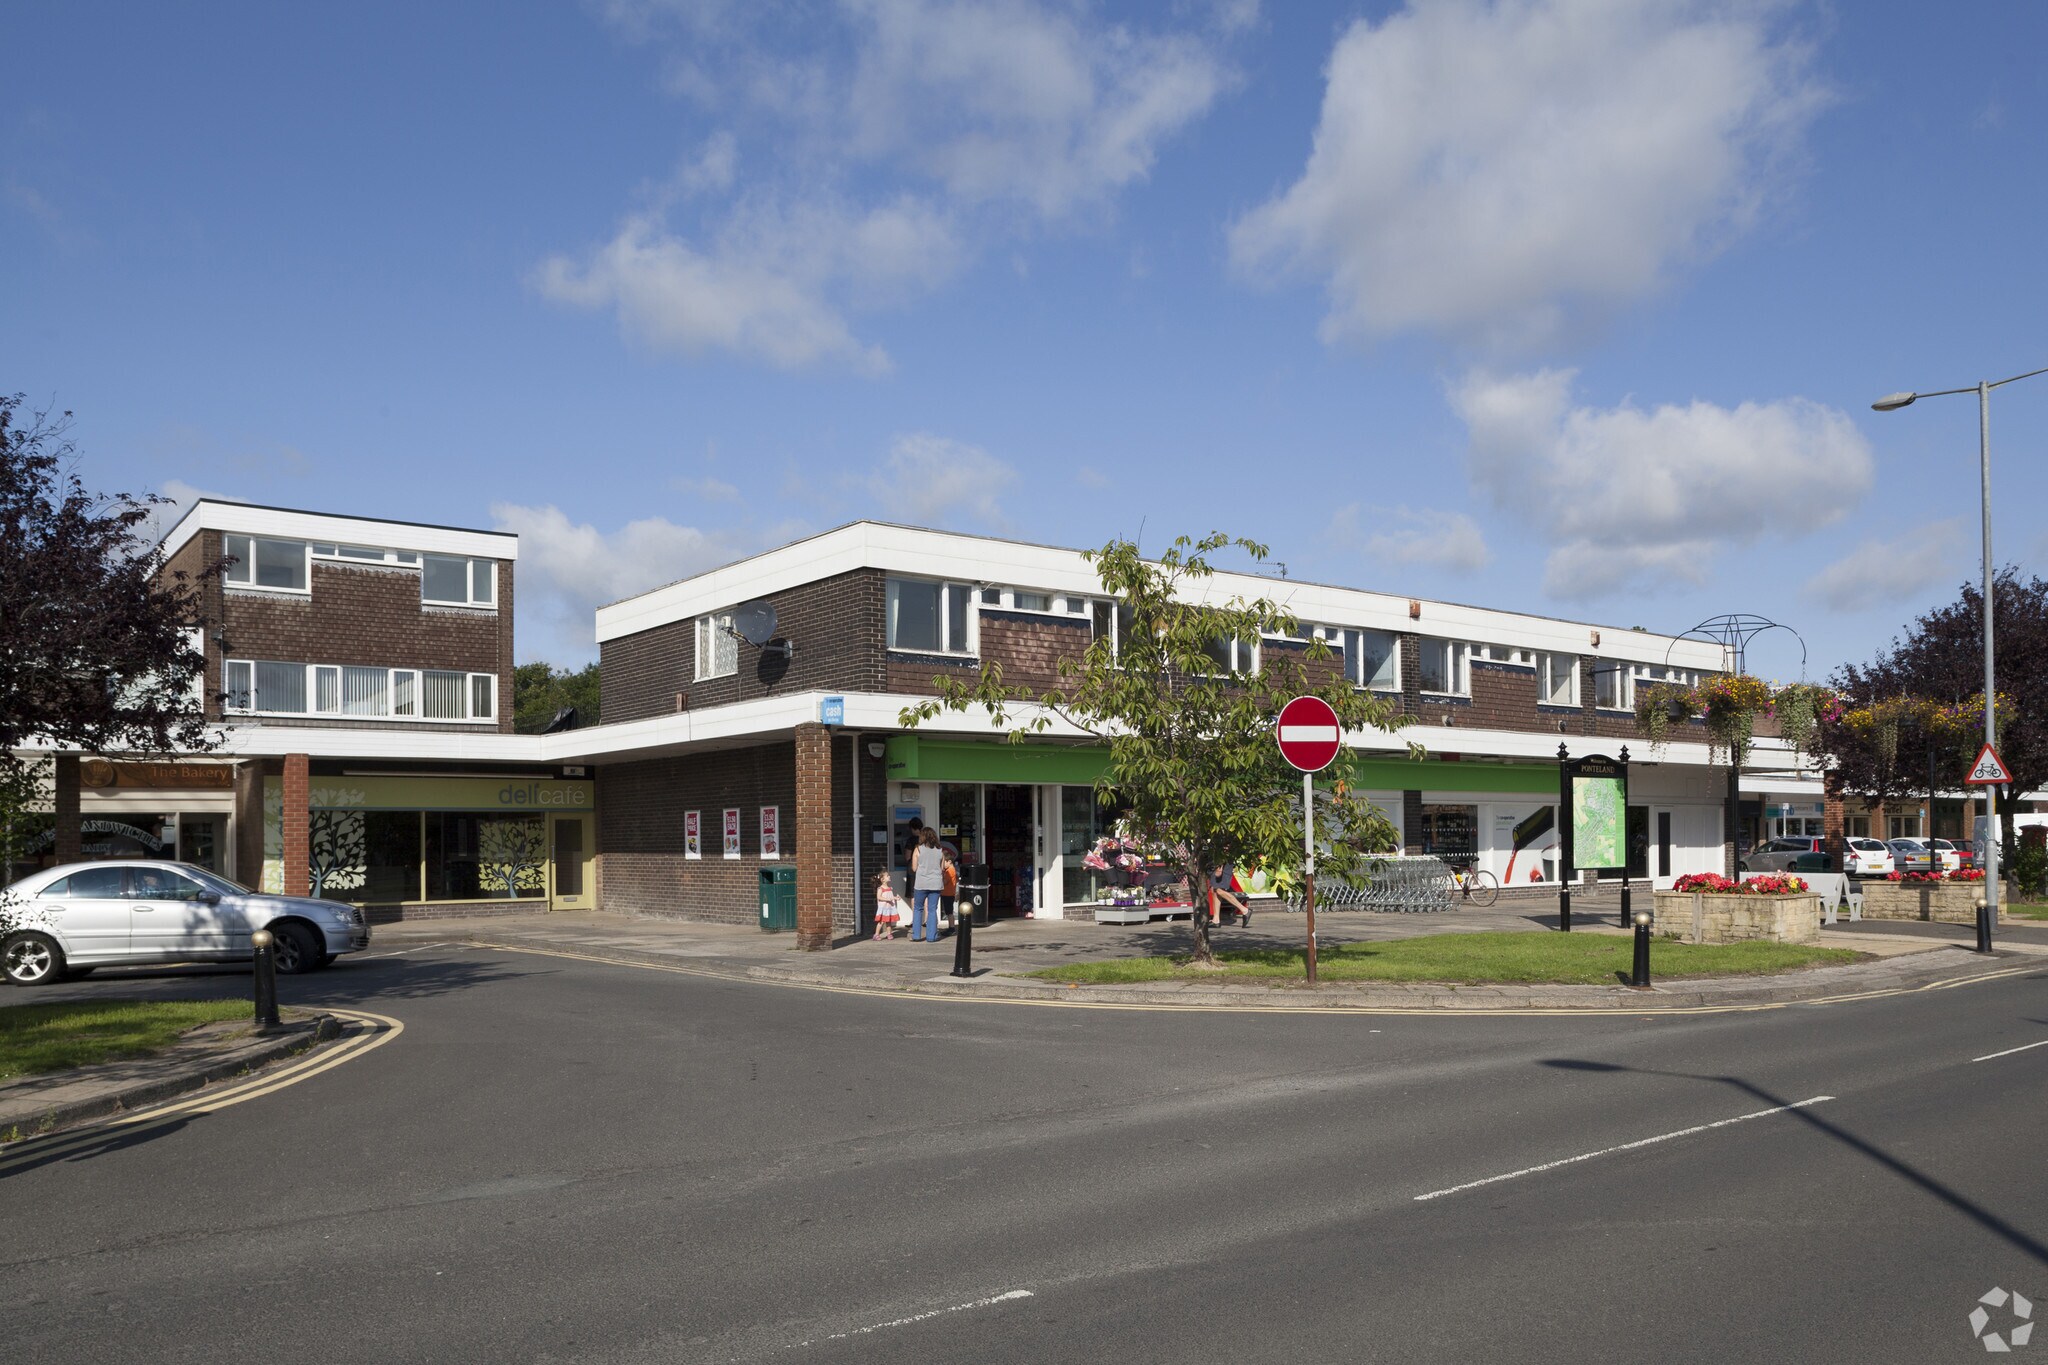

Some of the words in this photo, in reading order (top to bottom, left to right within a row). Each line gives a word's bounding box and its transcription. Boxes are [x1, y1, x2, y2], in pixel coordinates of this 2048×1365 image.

[826, 705, 842, 717] cash
[151, 767, 177, 777] The
[181, 767, 228, 780] Bakery
[1581, 764, 1615, 774] PONTELAND
[764, 821, 775, 829] EACH
[80, 820, 165, 852] ANDWICHES
